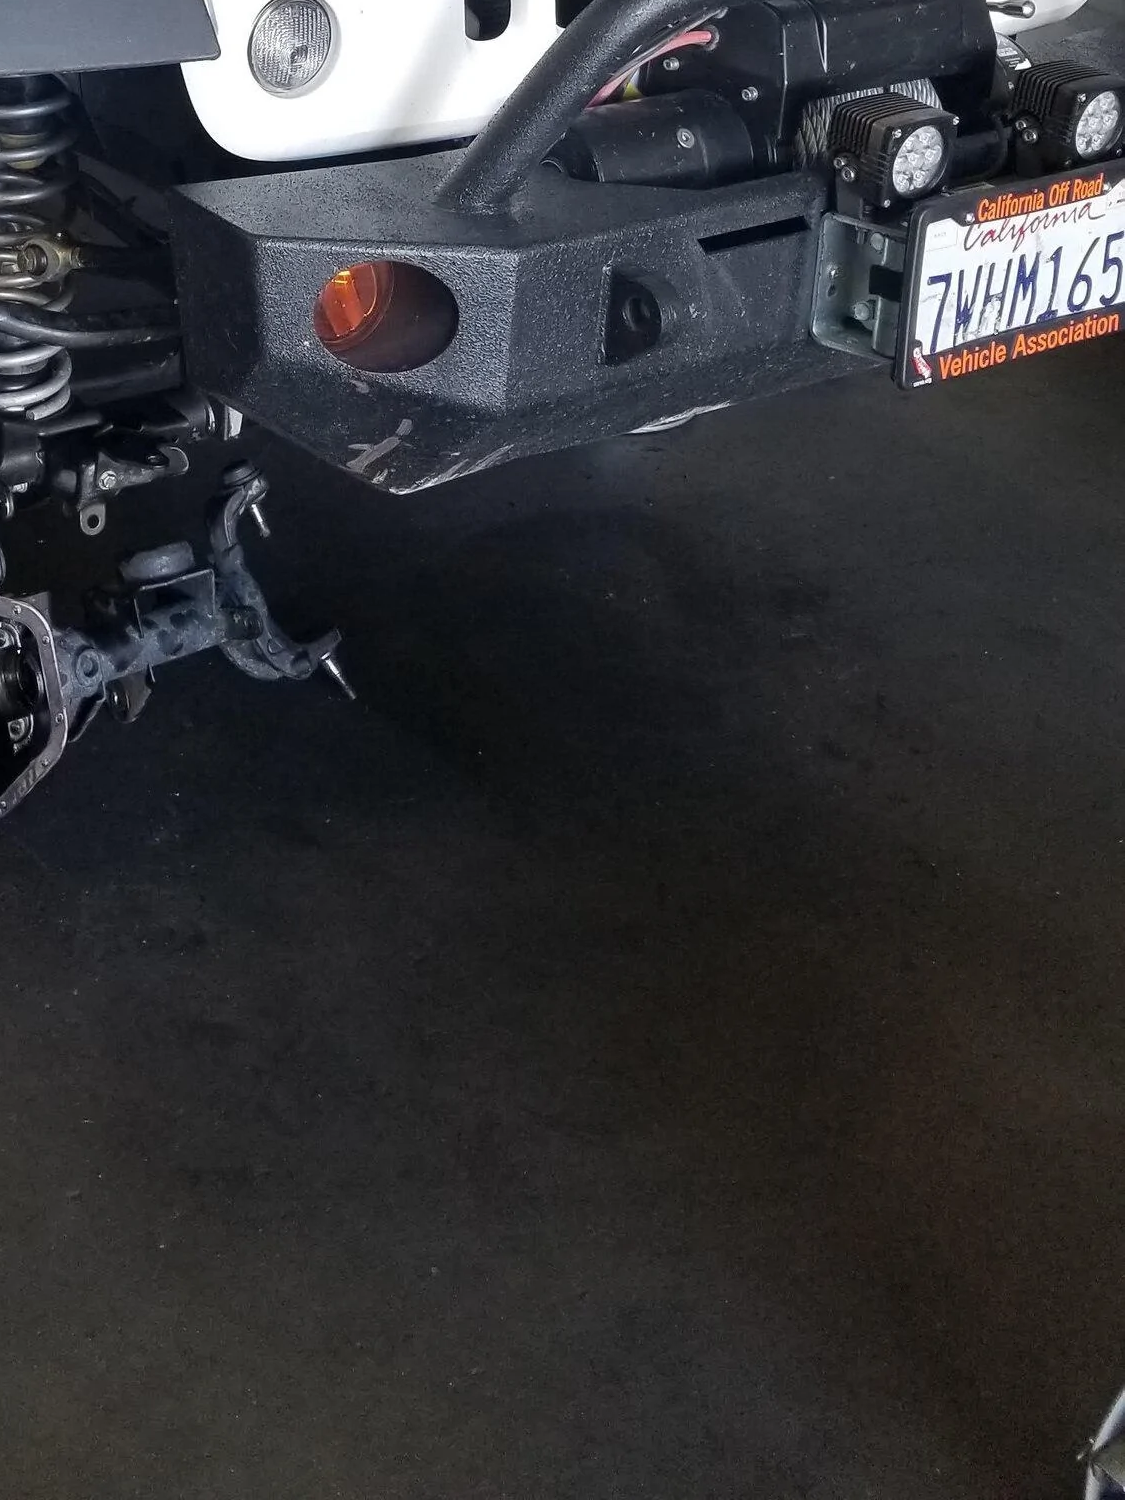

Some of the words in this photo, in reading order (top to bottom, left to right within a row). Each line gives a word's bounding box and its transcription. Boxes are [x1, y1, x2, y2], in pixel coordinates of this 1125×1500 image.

[977, 188, 1045, 223] California
[1048, 184, 1069, 208] Off
[1073, 172, 1105, 200] Road
[963, 202, 1106, 254] California
[926, 230, 1125, 355] 7WHM165
[939, 340, 1008, 380] Vehicle
[1011, 312, 1121, 360] Association
